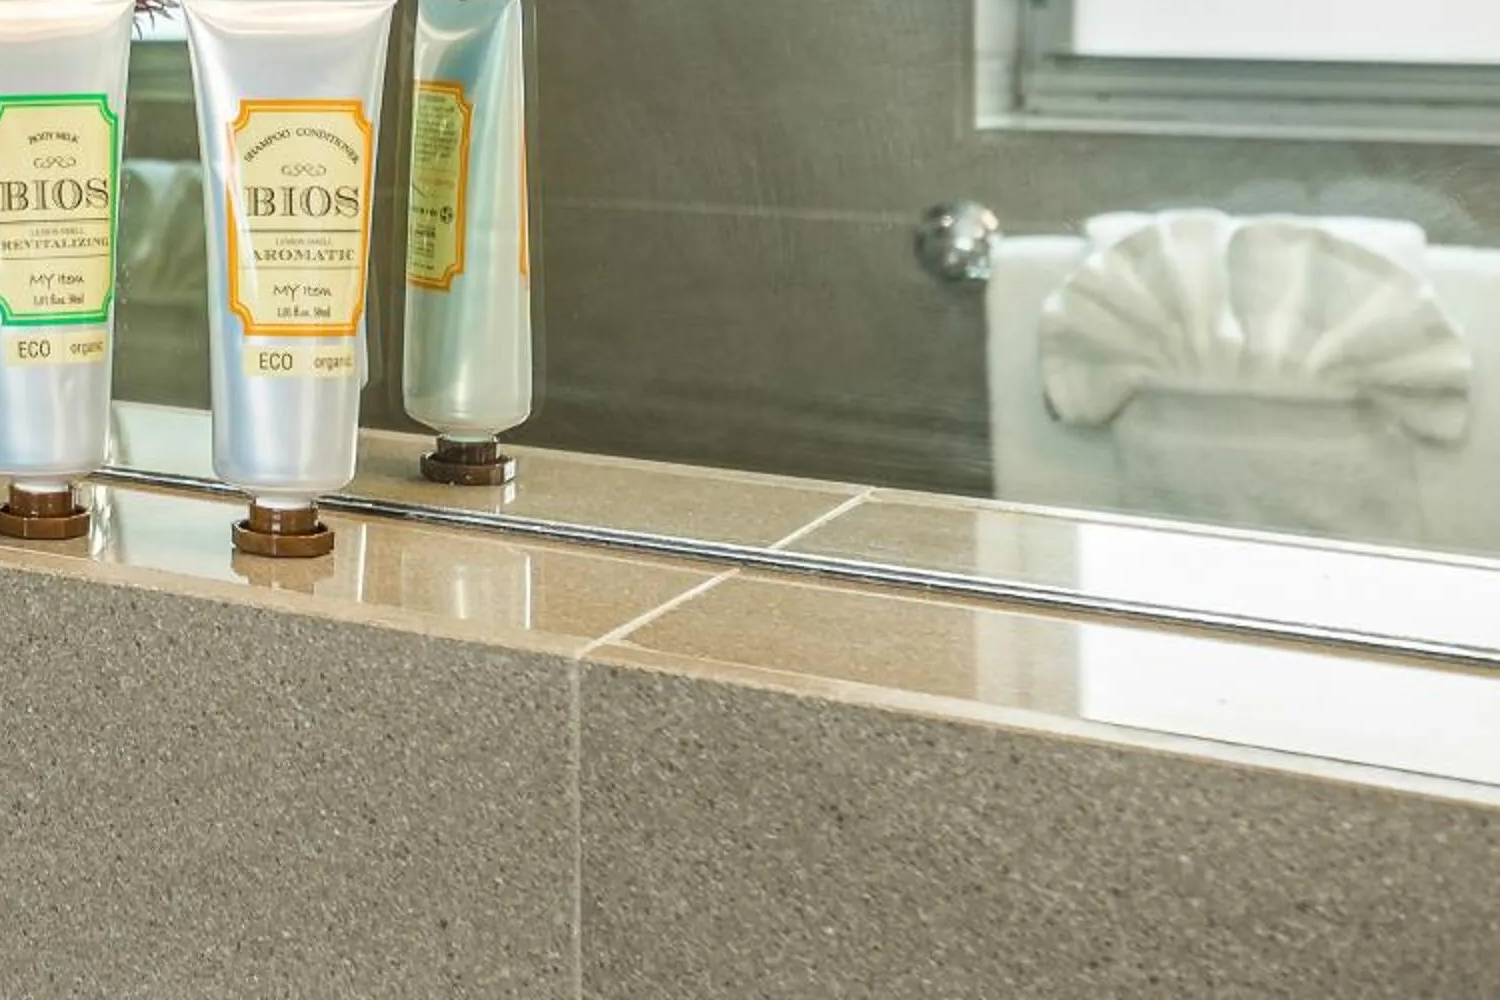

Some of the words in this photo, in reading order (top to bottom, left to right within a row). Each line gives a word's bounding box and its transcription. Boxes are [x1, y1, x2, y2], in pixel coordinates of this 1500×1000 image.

[244, 128, 291, 162] SHAMPOO
[295, 127, 359, 165] CONDITIONER
[244, 185, 359, 218] BIOS
[1, 236, 109, 251] REVITALIZING
[253, 249, 355, 262] AROMATIC
[29, 273, 55, 290] MY
[273, 284, 300, 302] MY
[18, 339, 51, 359] ECO
[258, 352, 293, 371] ECO
